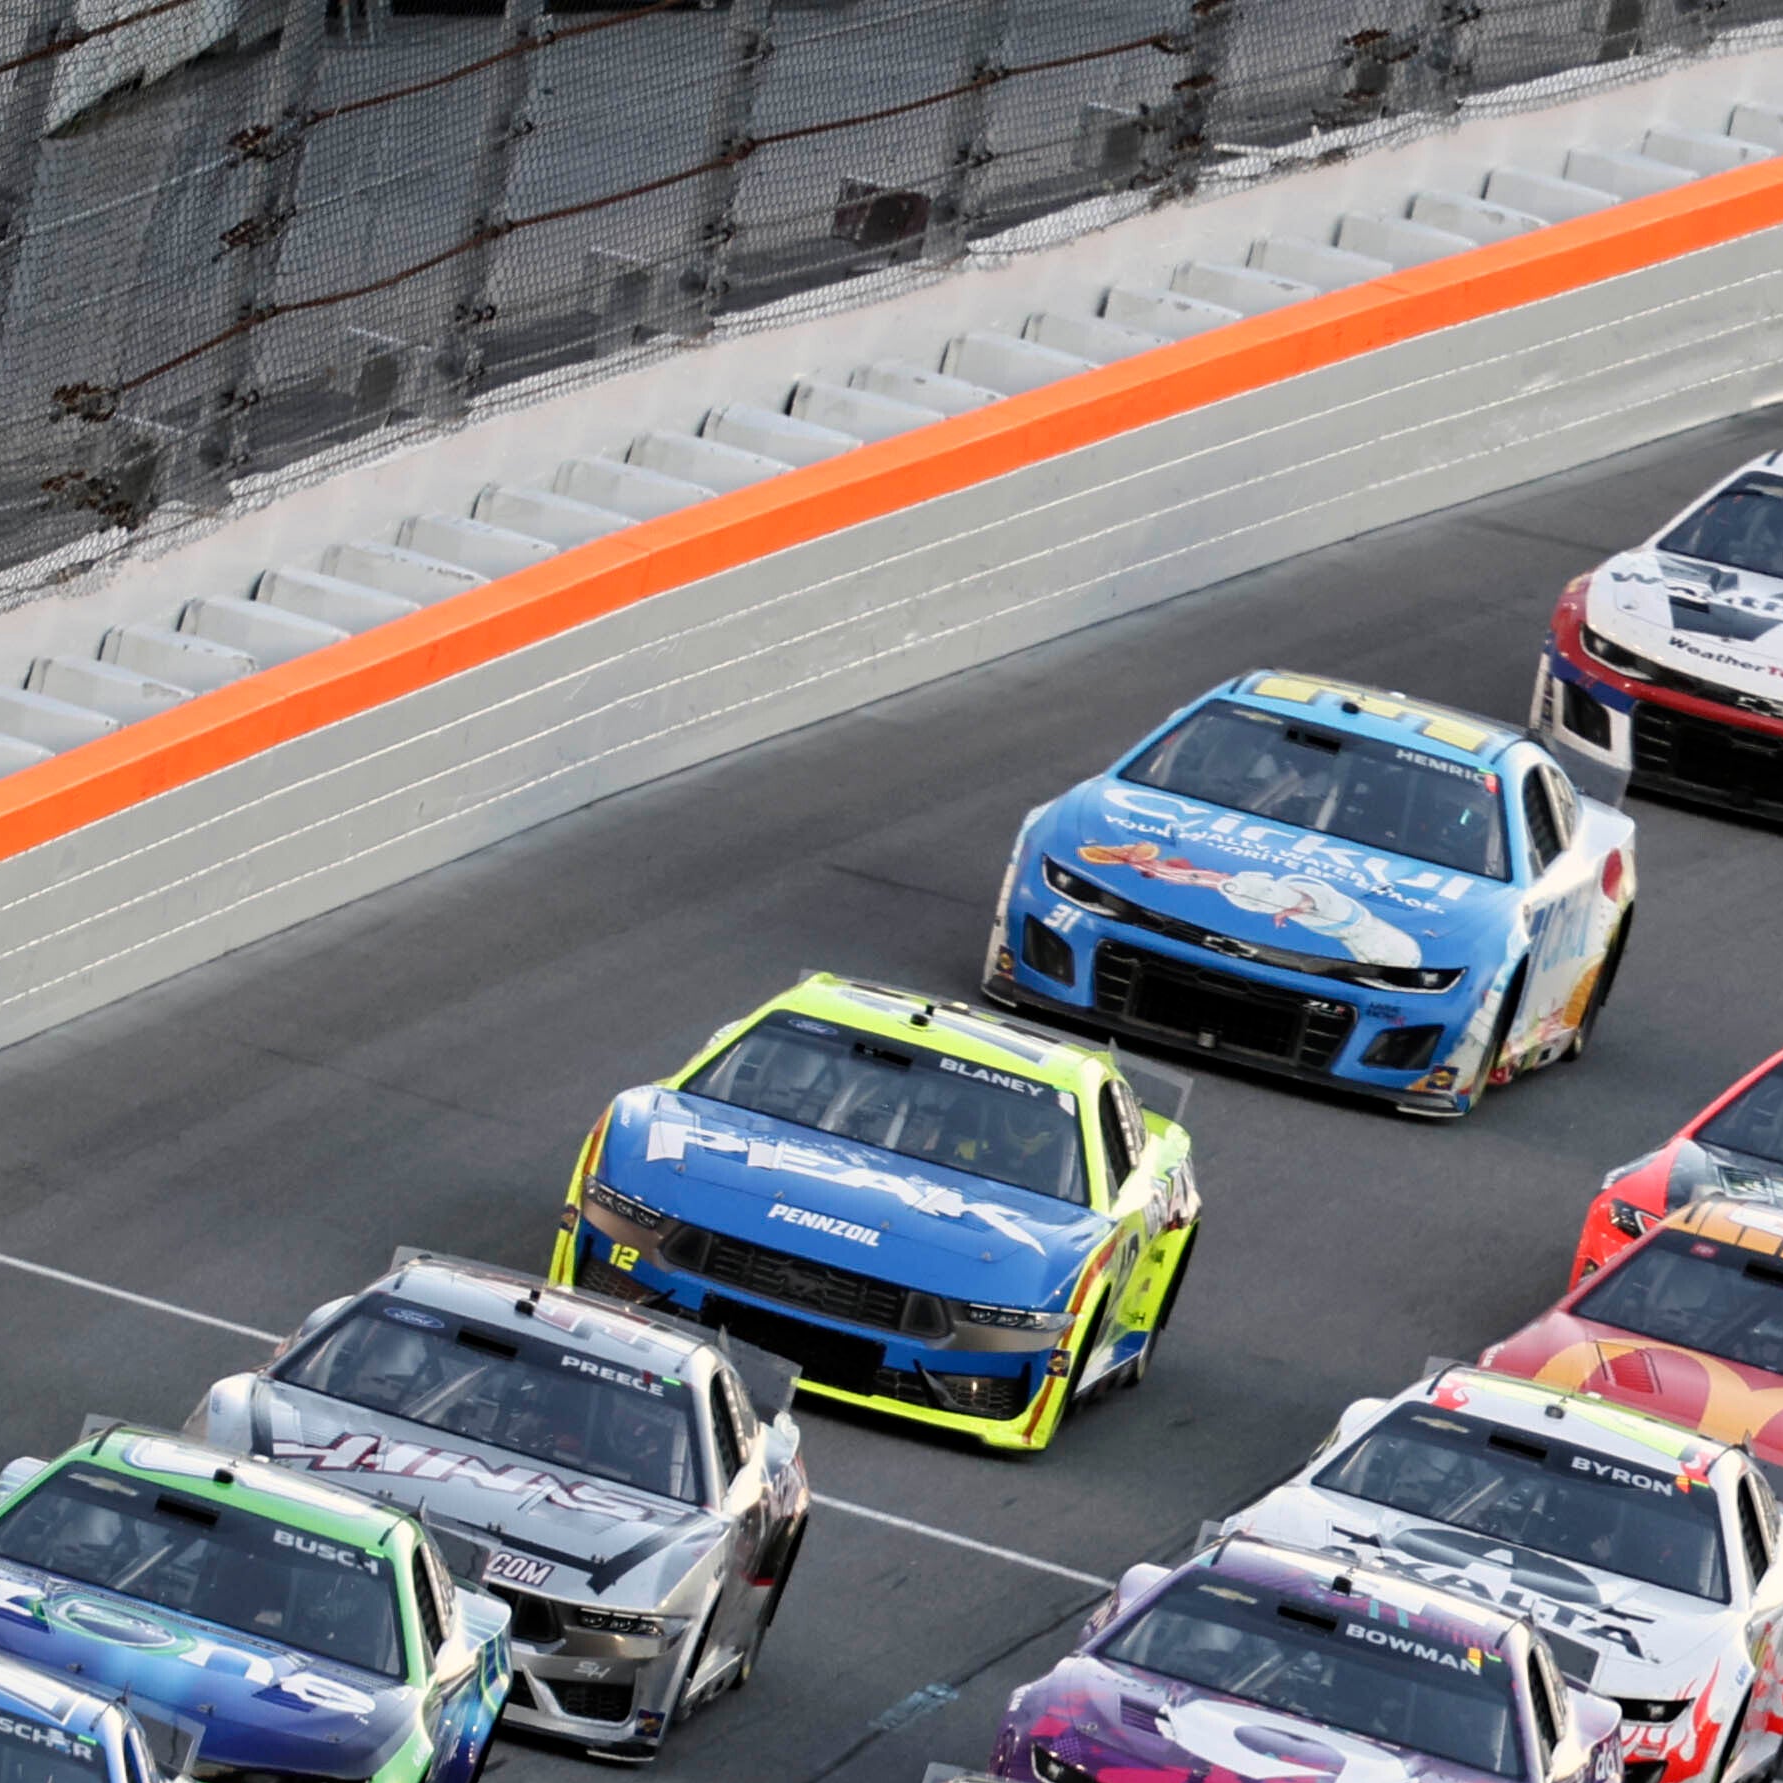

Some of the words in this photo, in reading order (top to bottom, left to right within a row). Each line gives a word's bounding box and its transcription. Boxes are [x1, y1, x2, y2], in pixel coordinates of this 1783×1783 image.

[1043, 902, 1083, 934] 31
[939, 1057, 1044, 1098] BLANEY
[768, 1202, 881, 1248] PENNZOIL
[608, 1241, 641, 1273] 12
[560, 1354, 665, 1398] PREECE
[1571, 1456, 1673, 1497] BYRON
[273, 1528, 379, 1575] BUSCH
